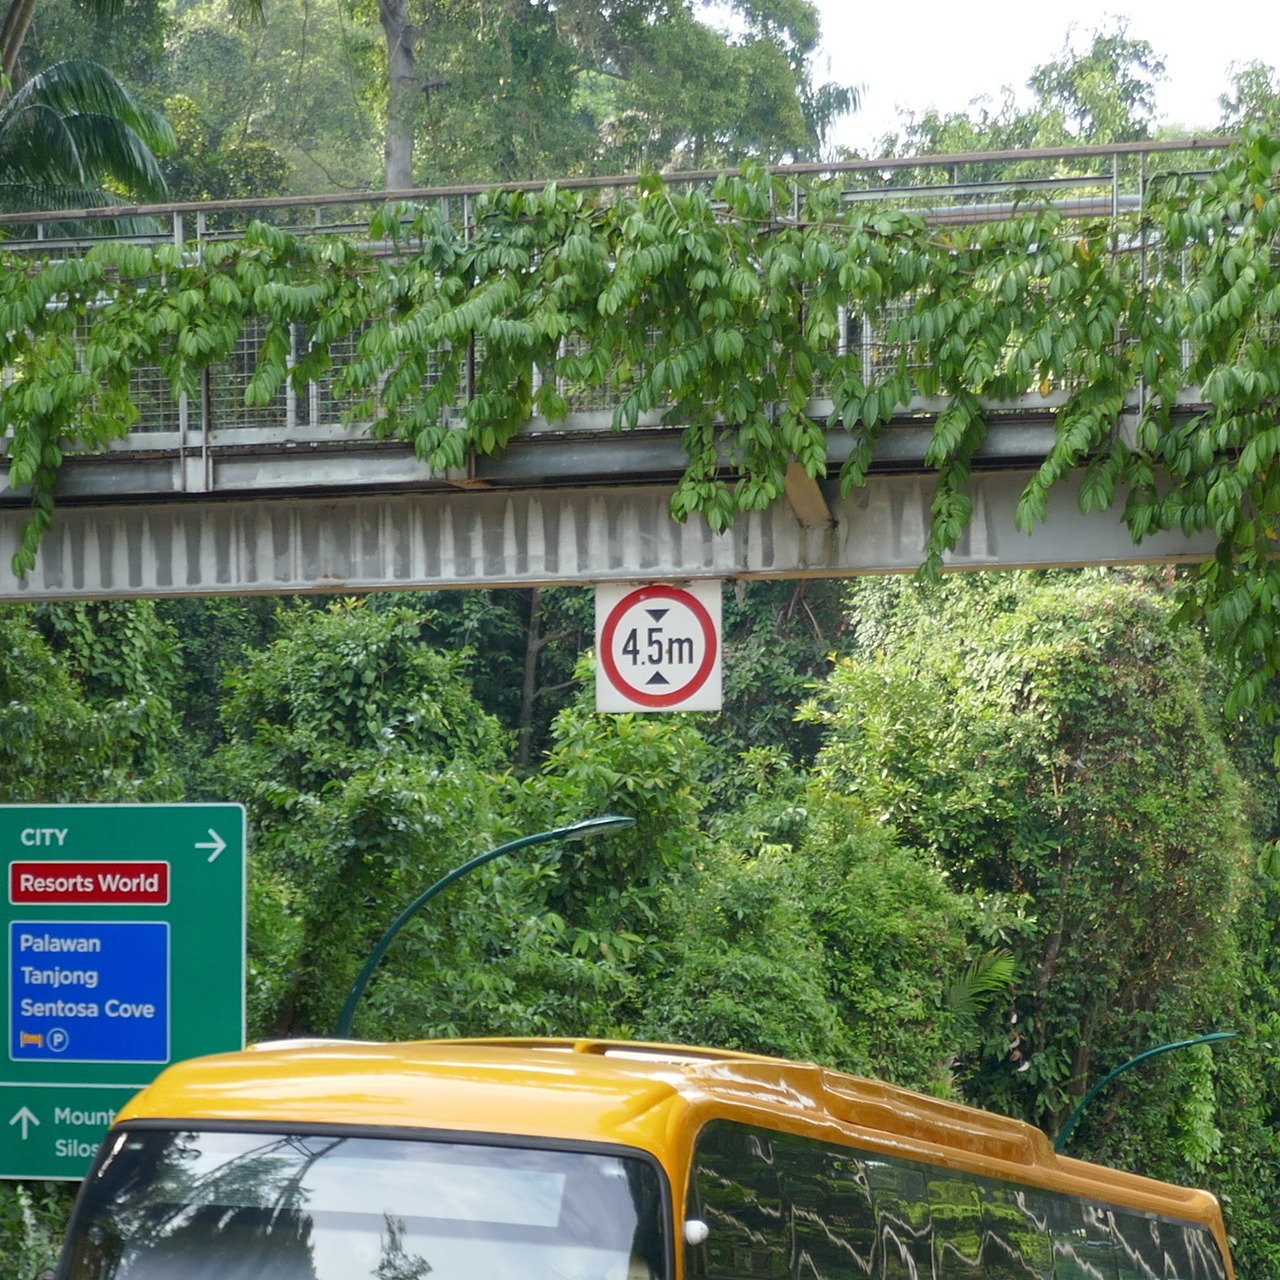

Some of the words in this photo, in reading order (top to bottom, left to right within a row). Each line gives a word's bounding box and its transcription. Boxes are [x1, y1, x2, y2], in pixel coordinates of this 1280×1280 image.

[622, 627, 694, 666] 4.5m
[20, 828, 68, 846] CITY
[20, 874, 94, 892] Resorts
[98, 873, 159, 892] World
[20, 933, 101, 952] Palawan
[20, 966, 99, 989] Tanjong
[20, 998, 99, 1017] Sentosa
[104, 999, 155, 1018] Cove
[53, 1033, 64, 1047] P
[54, 1107, 116, 1125] Mount
[55, 1139, 100, 1158] Silos
